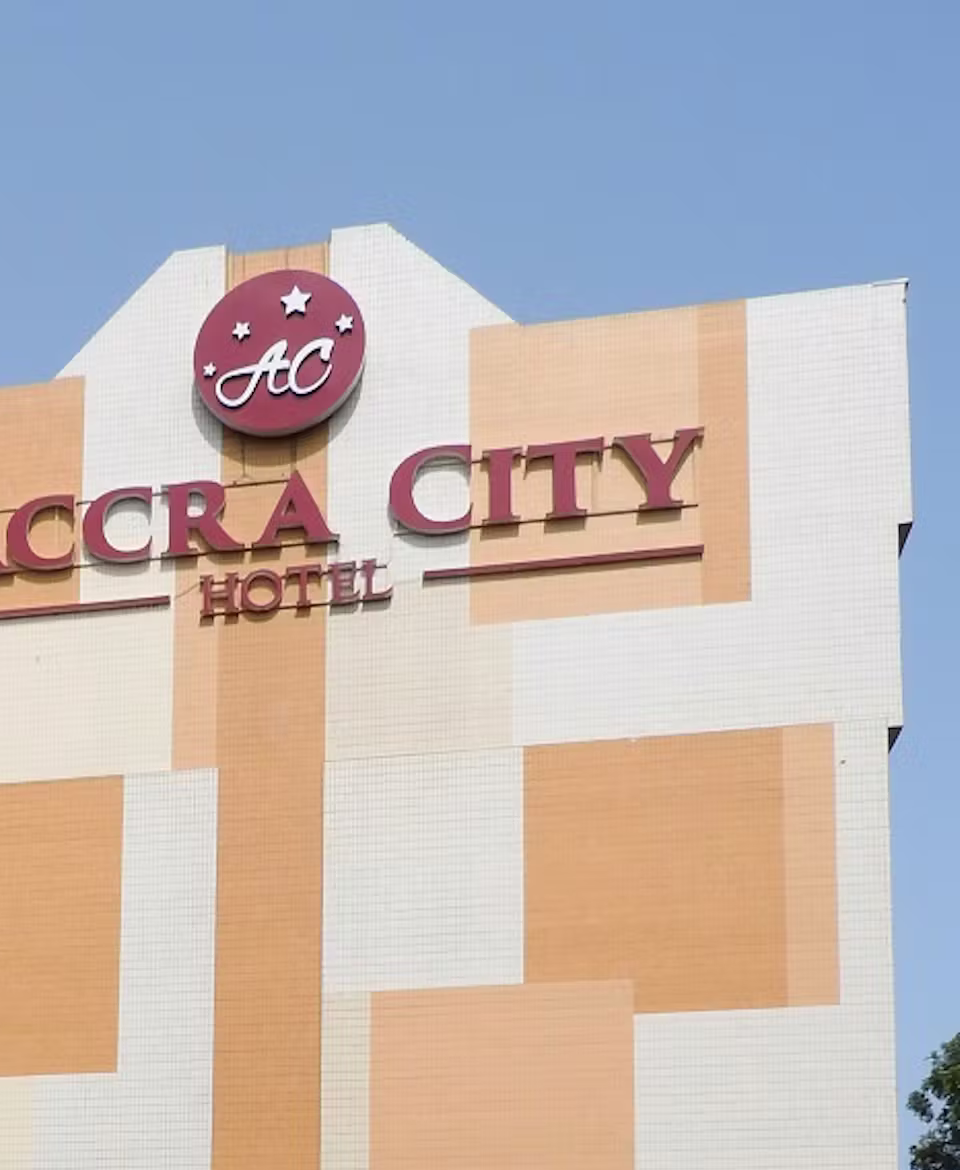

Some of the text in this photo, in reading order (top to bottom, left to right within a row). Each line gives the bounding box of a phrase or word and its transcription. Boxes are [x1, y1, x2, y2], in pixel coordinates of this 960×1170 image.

[215, 338, 334, 407] AC
[389, 427, 704, 535] CITY
[200, 558, 393, 624] HOTEL
